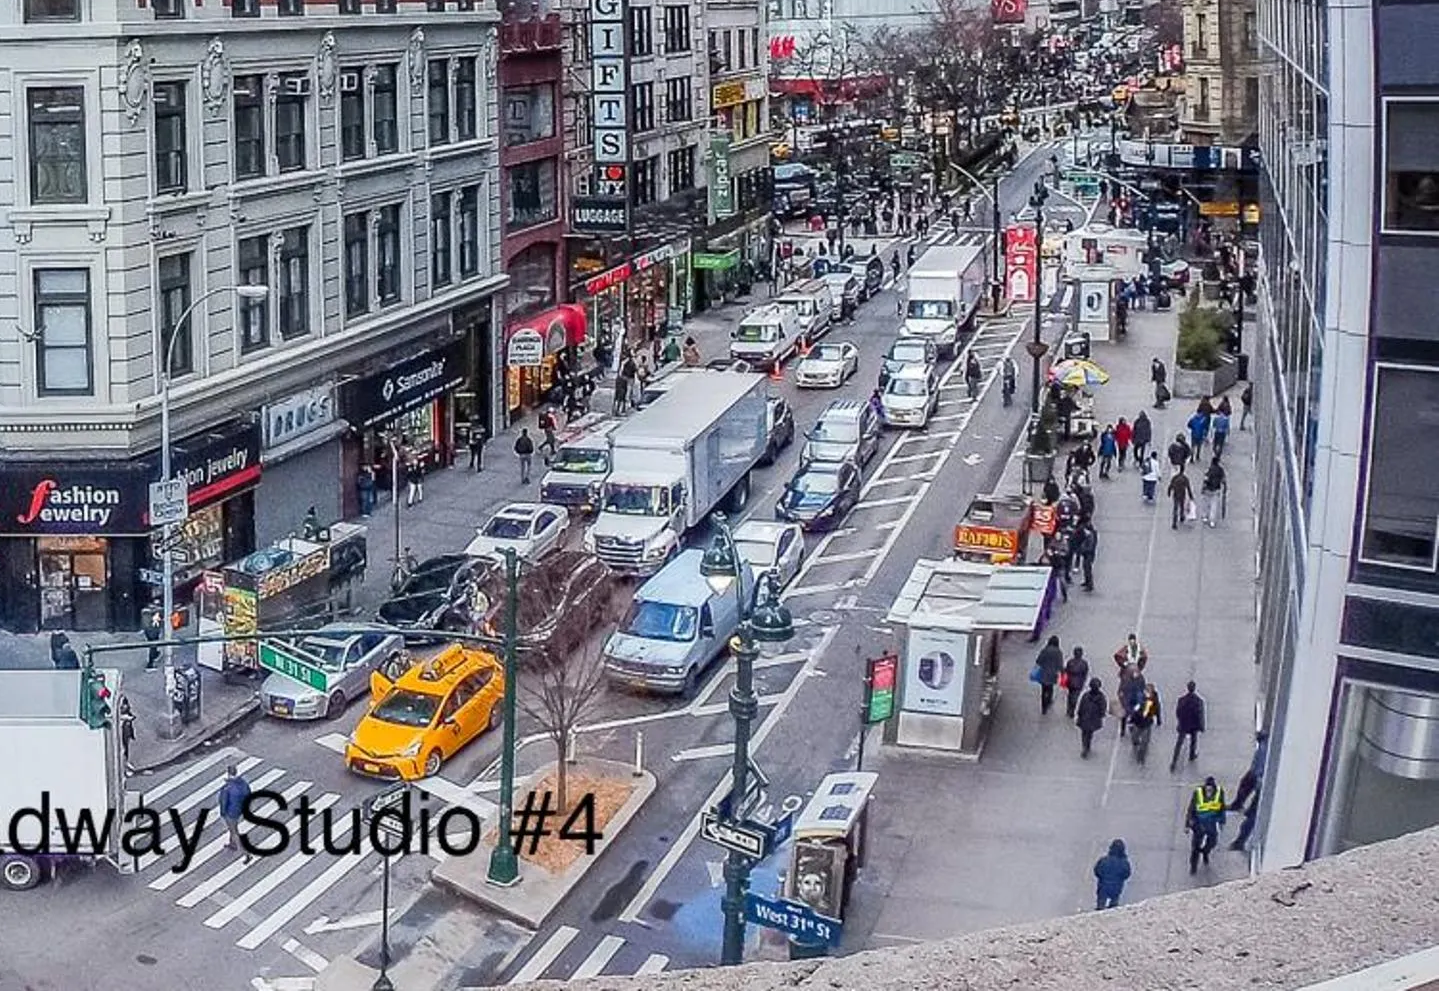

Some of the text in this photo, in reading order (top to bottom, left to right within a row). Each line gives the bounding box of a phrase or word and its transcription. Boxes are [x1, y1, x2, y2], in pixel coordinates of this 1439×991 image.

[714, 151, 731, 198] zipcar
[575, 208, 626, 224] LUGGAGE
[396, 360, 444, 394] Samsonite
[206, 447, 248, 485] jewelry
[755, 903, 788, 927] West
[816, 922, 830, 940] St
